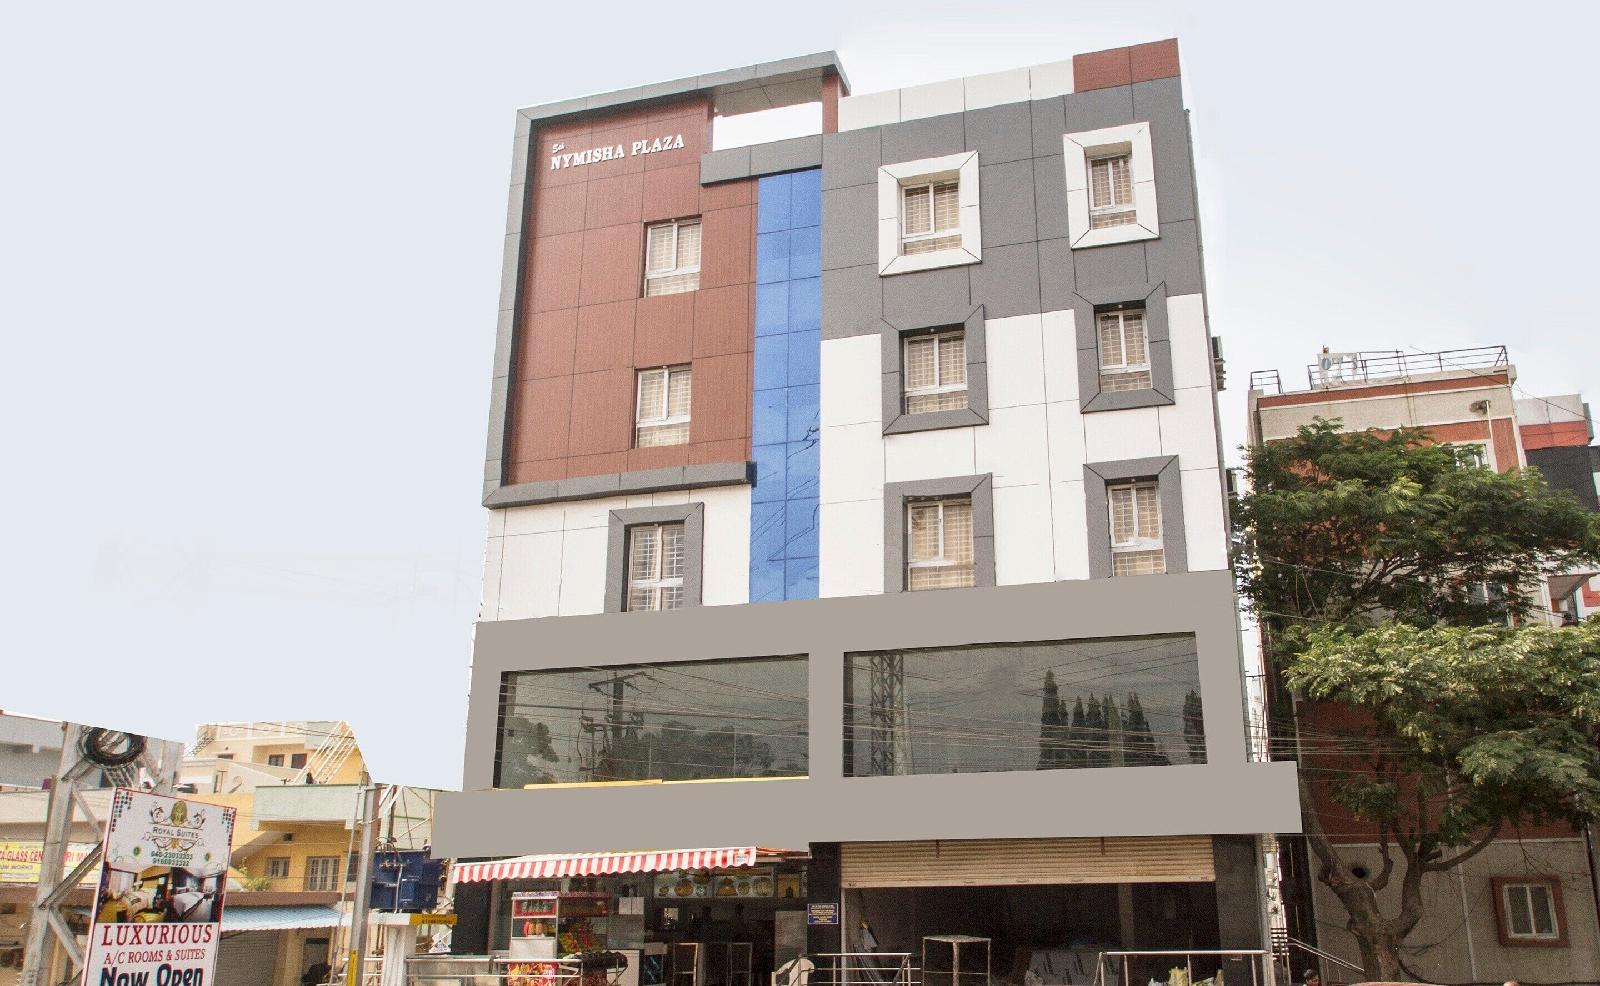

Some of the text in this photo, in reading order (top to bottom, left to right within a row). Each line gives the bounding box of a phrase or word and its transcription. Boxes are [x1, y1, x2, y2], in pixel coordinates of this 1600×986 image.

[551, 134, 685, 170] NYMISHA PLAZA
[152, 826, 199, 839] ROYAL SUITES
[7, 850, 28, 862] GLASS
[101, 924, 212, 945] LUXURIOUS
[103, 948, 206, 966] A/C ROOMS & SUITES
[100, 963, 204, 986] Now Open
